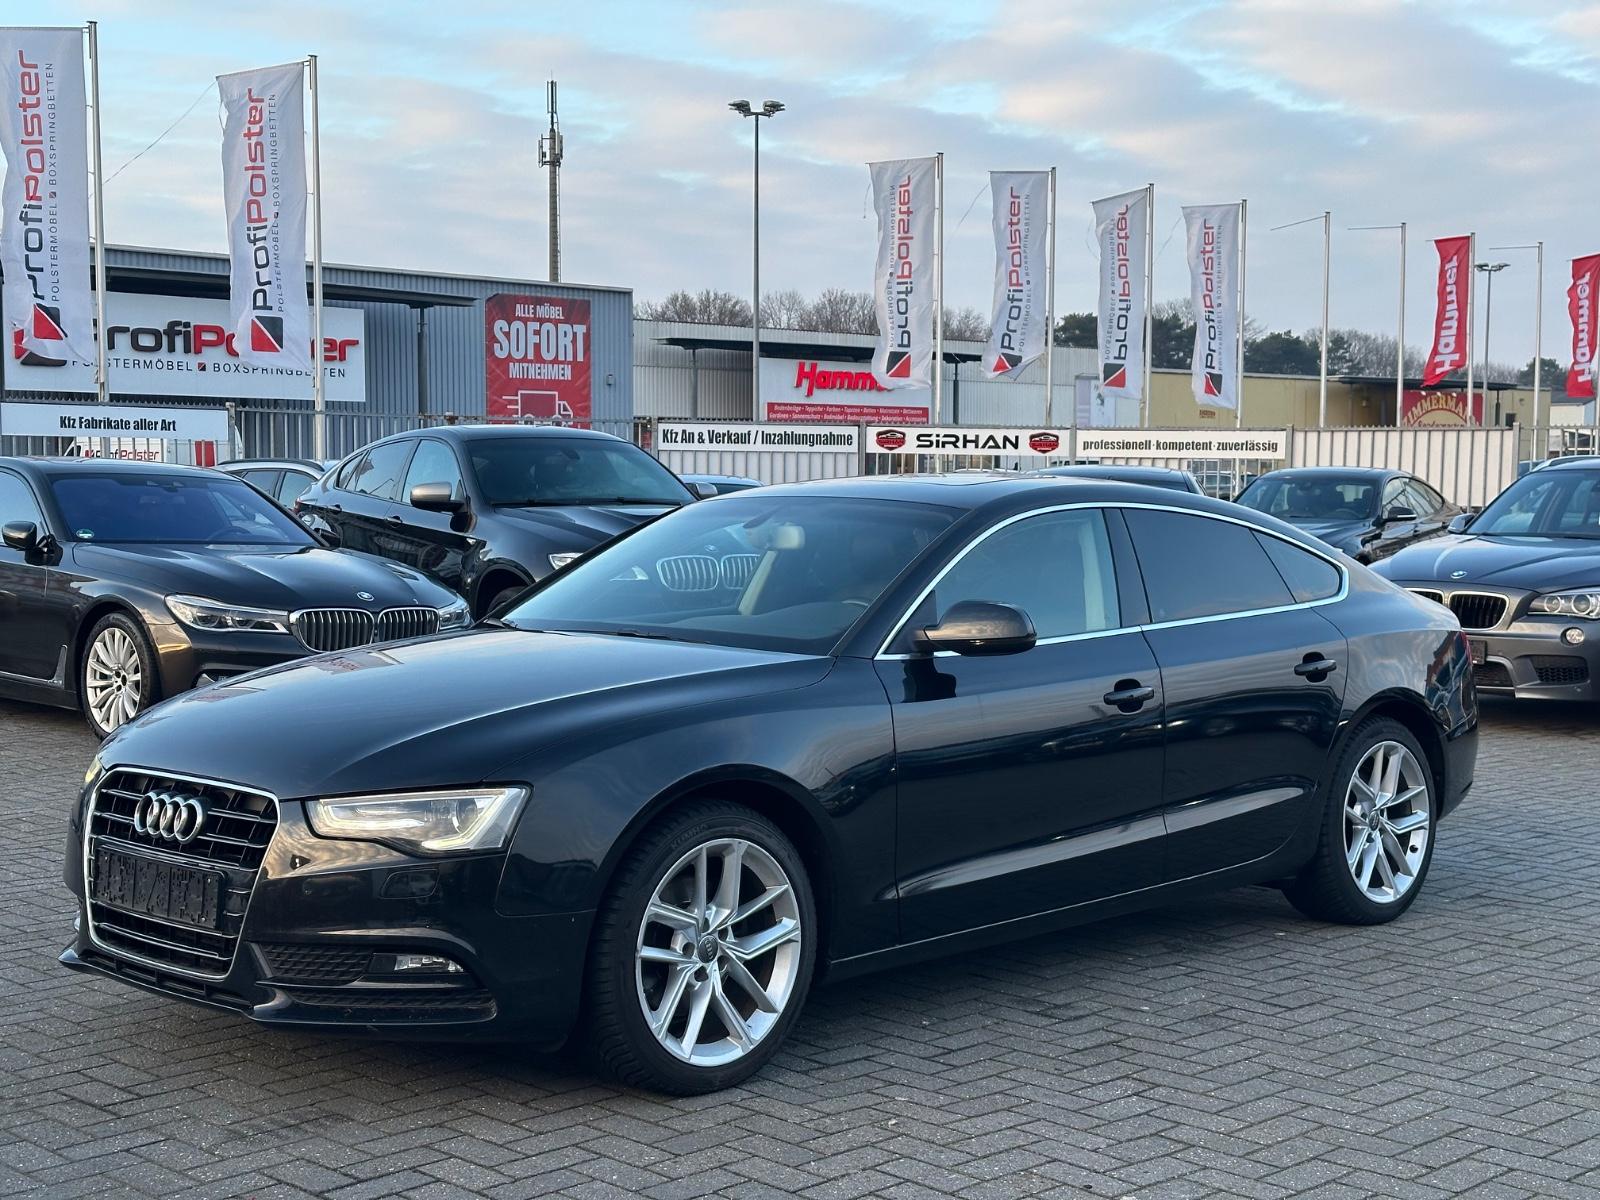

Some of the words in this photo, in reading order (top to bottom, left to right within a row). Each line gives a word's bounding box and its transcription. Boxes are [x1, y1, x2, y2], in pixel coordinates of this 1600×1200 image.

[45, 62, 57, 186] BOXSPRINGBETTEN
[268, 93, 280, 207] BOXSPRINGBETTEN
[243, 88, 273, 311] ProfiPolster
[49, 204, 60, 302] POLSTERMÖBEL
[1000, 186, 1024, 351] ProfiPolster
[515, 303, 535, 319] ALLE
[536, 303, 564, 320] MÖBEL
[1200, 218, 1217, 370] ProfiPolster
[493, 319, 587, 362] SOFORT
[508, 362, 572, 381] MITNEHMEN
[794, 361, 895, 398] Hamm
[60, 415, 77, 429] Kfz
[79, 416, 131, 431] Fabrikate
[133, 418, 159, 431] aller
[160, 419, 177, 432] Art
[662, 429, 679, 444] Kfz
[681, 430, 695, 444] An
[697, 430, 705, 444] &
[707, 429, 752, 444] Verkauf
[761, 430, 853, 447] Inzahlungnahme
